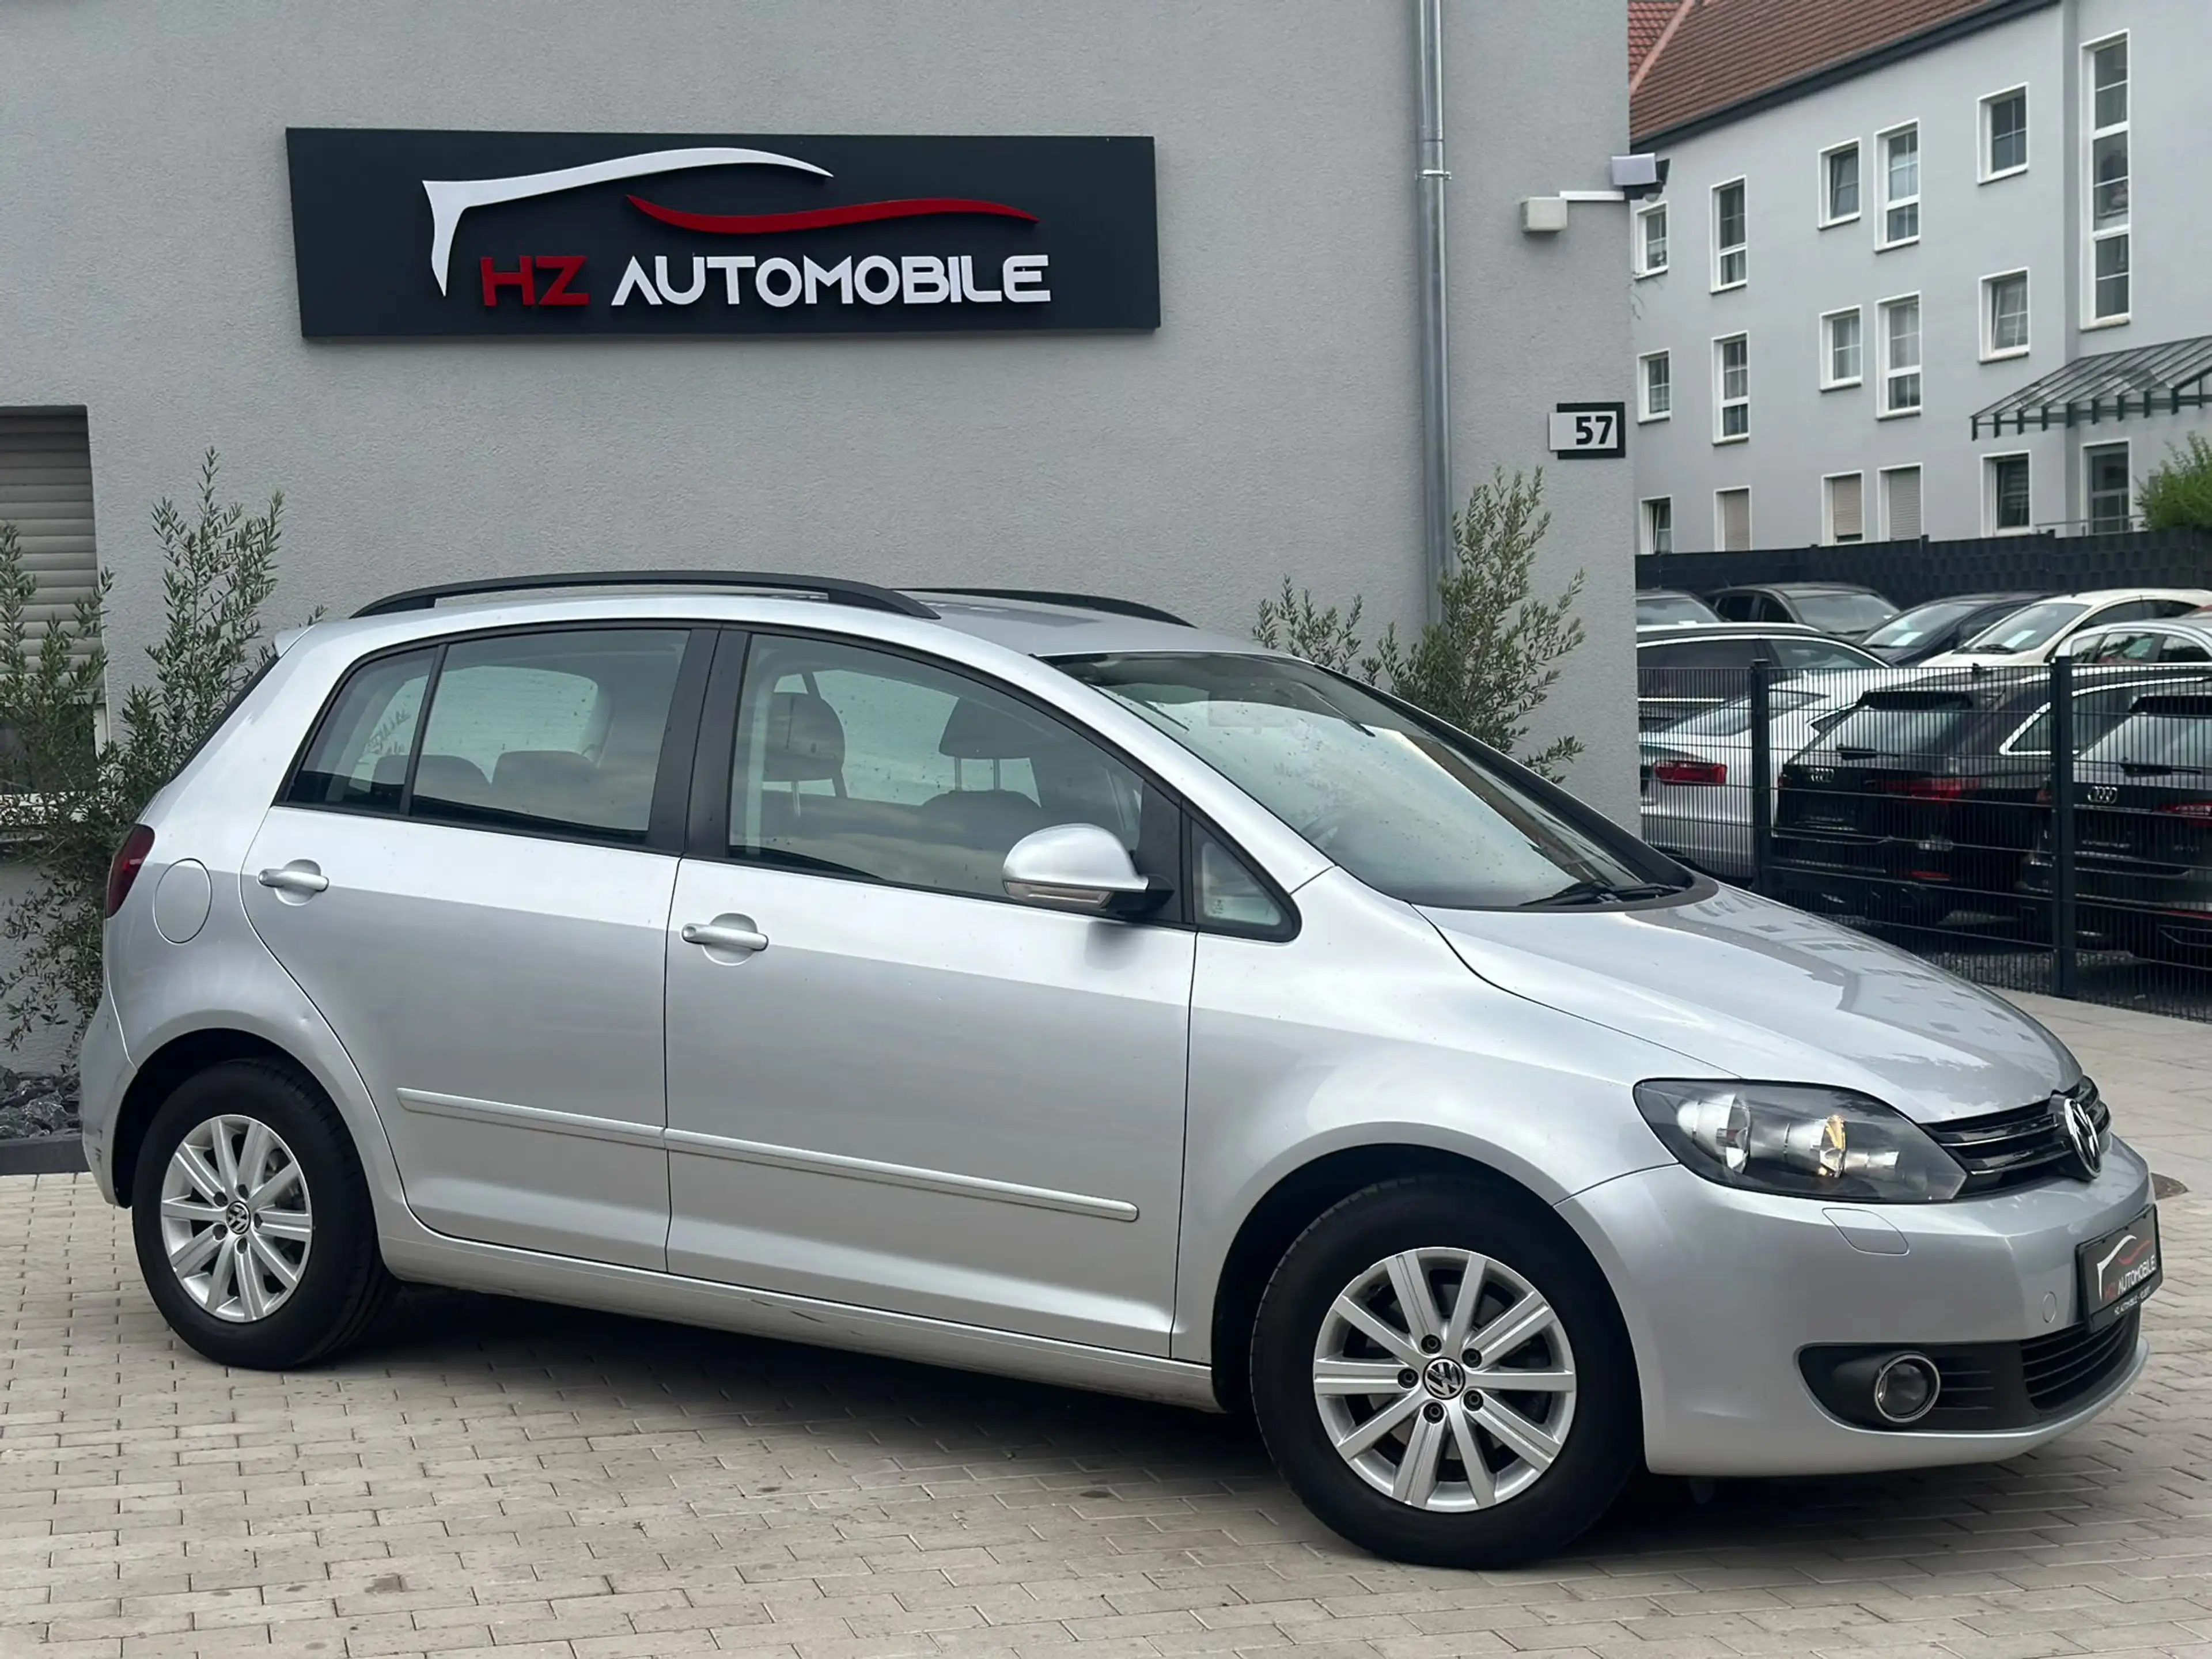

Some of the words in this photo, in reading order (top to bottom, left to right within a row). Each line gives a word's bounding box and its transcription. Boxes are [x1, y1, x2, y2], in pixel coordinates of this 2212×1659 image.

[480, 255, 590, 306] HZ
[611, 254, 1051, 307] AUTOMOBILE
[1575, 415, 1613, 446] 57
[2118, 1254, 2156, 1296] AUTOMOBILE
